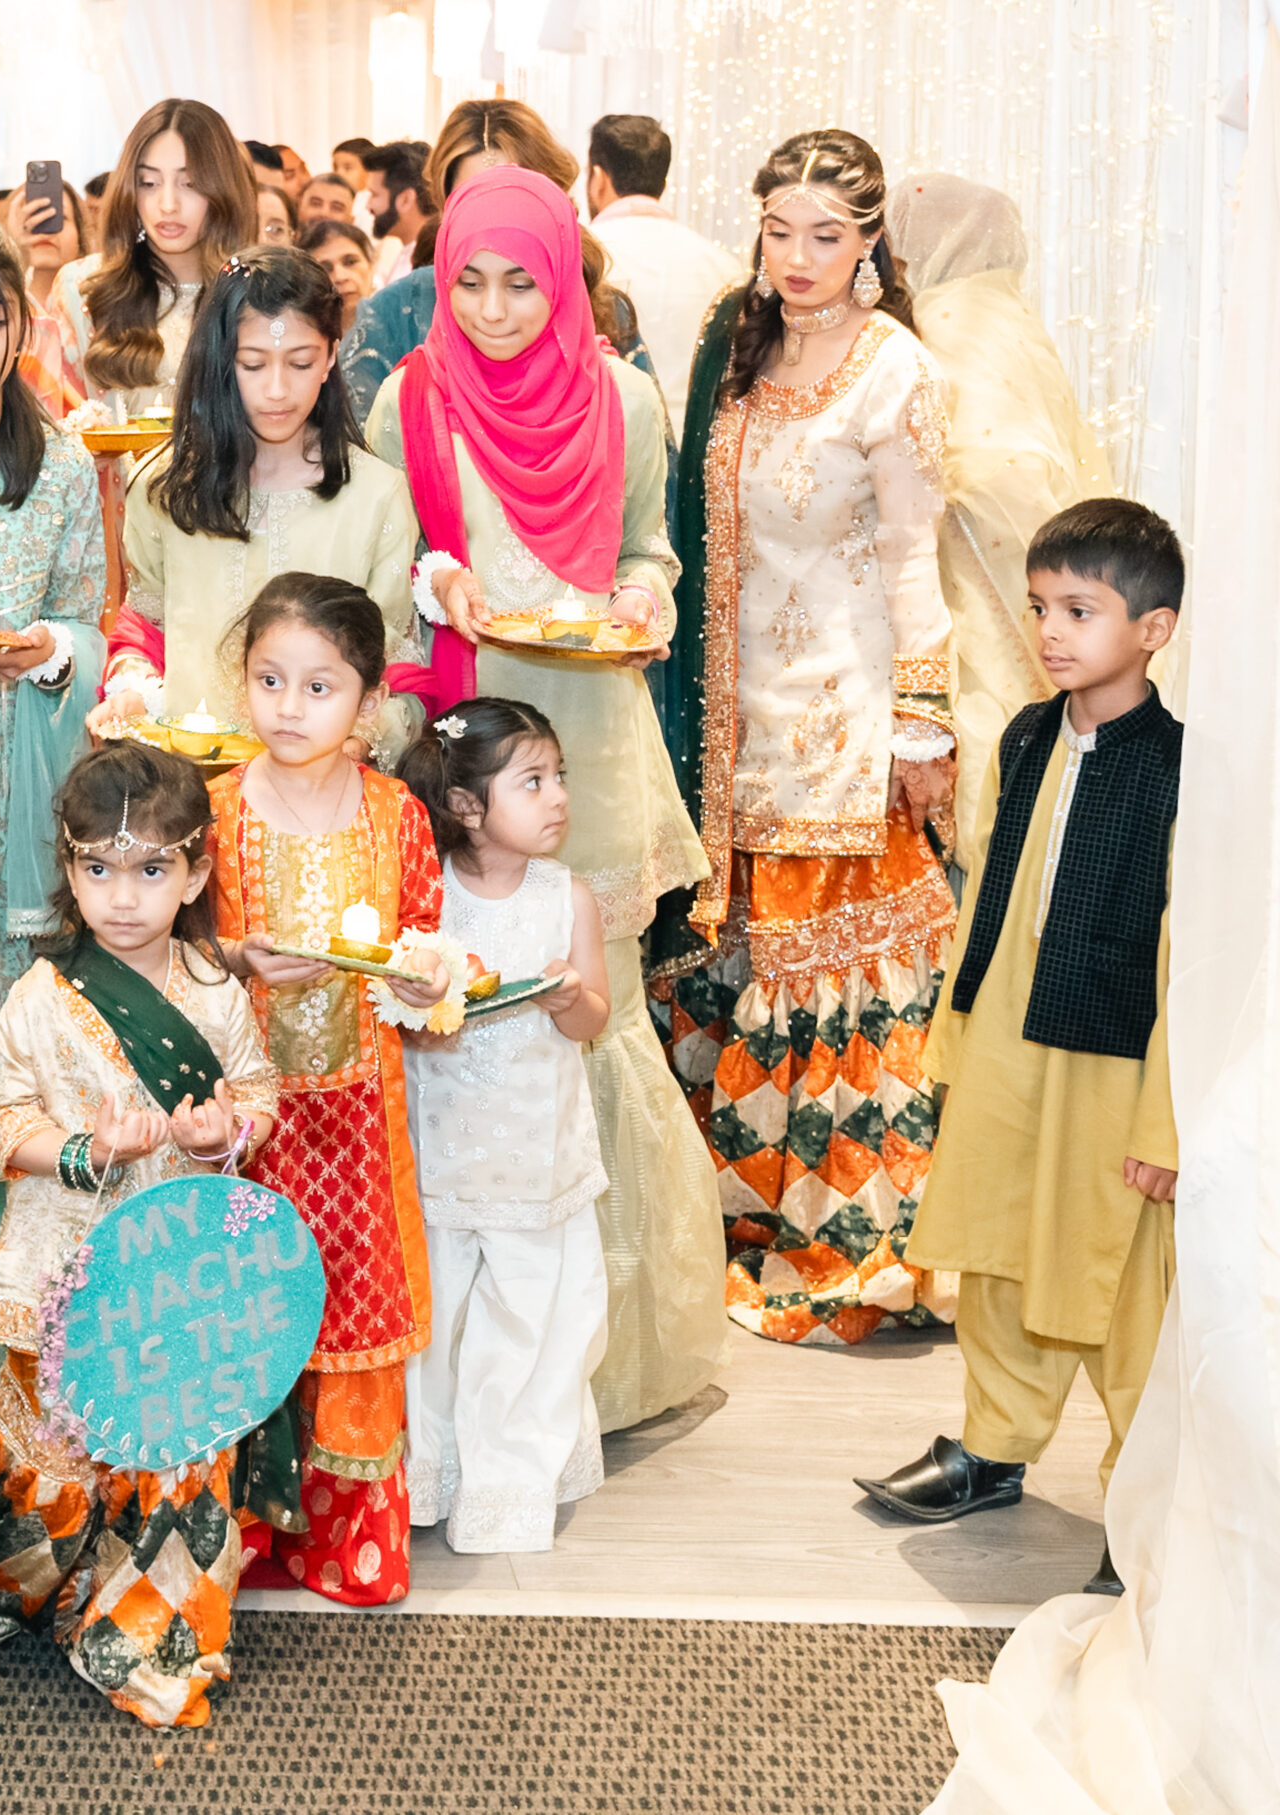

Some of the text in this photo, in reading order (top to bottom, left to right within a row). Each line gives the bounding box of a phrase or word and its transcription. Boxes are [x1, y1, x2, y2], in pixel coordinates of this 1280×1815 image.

[119, 1188, 200, 1264] MY
[107, 1285, 291, 1395] IS THE
[139, 1350, 275, 1444] BEST
